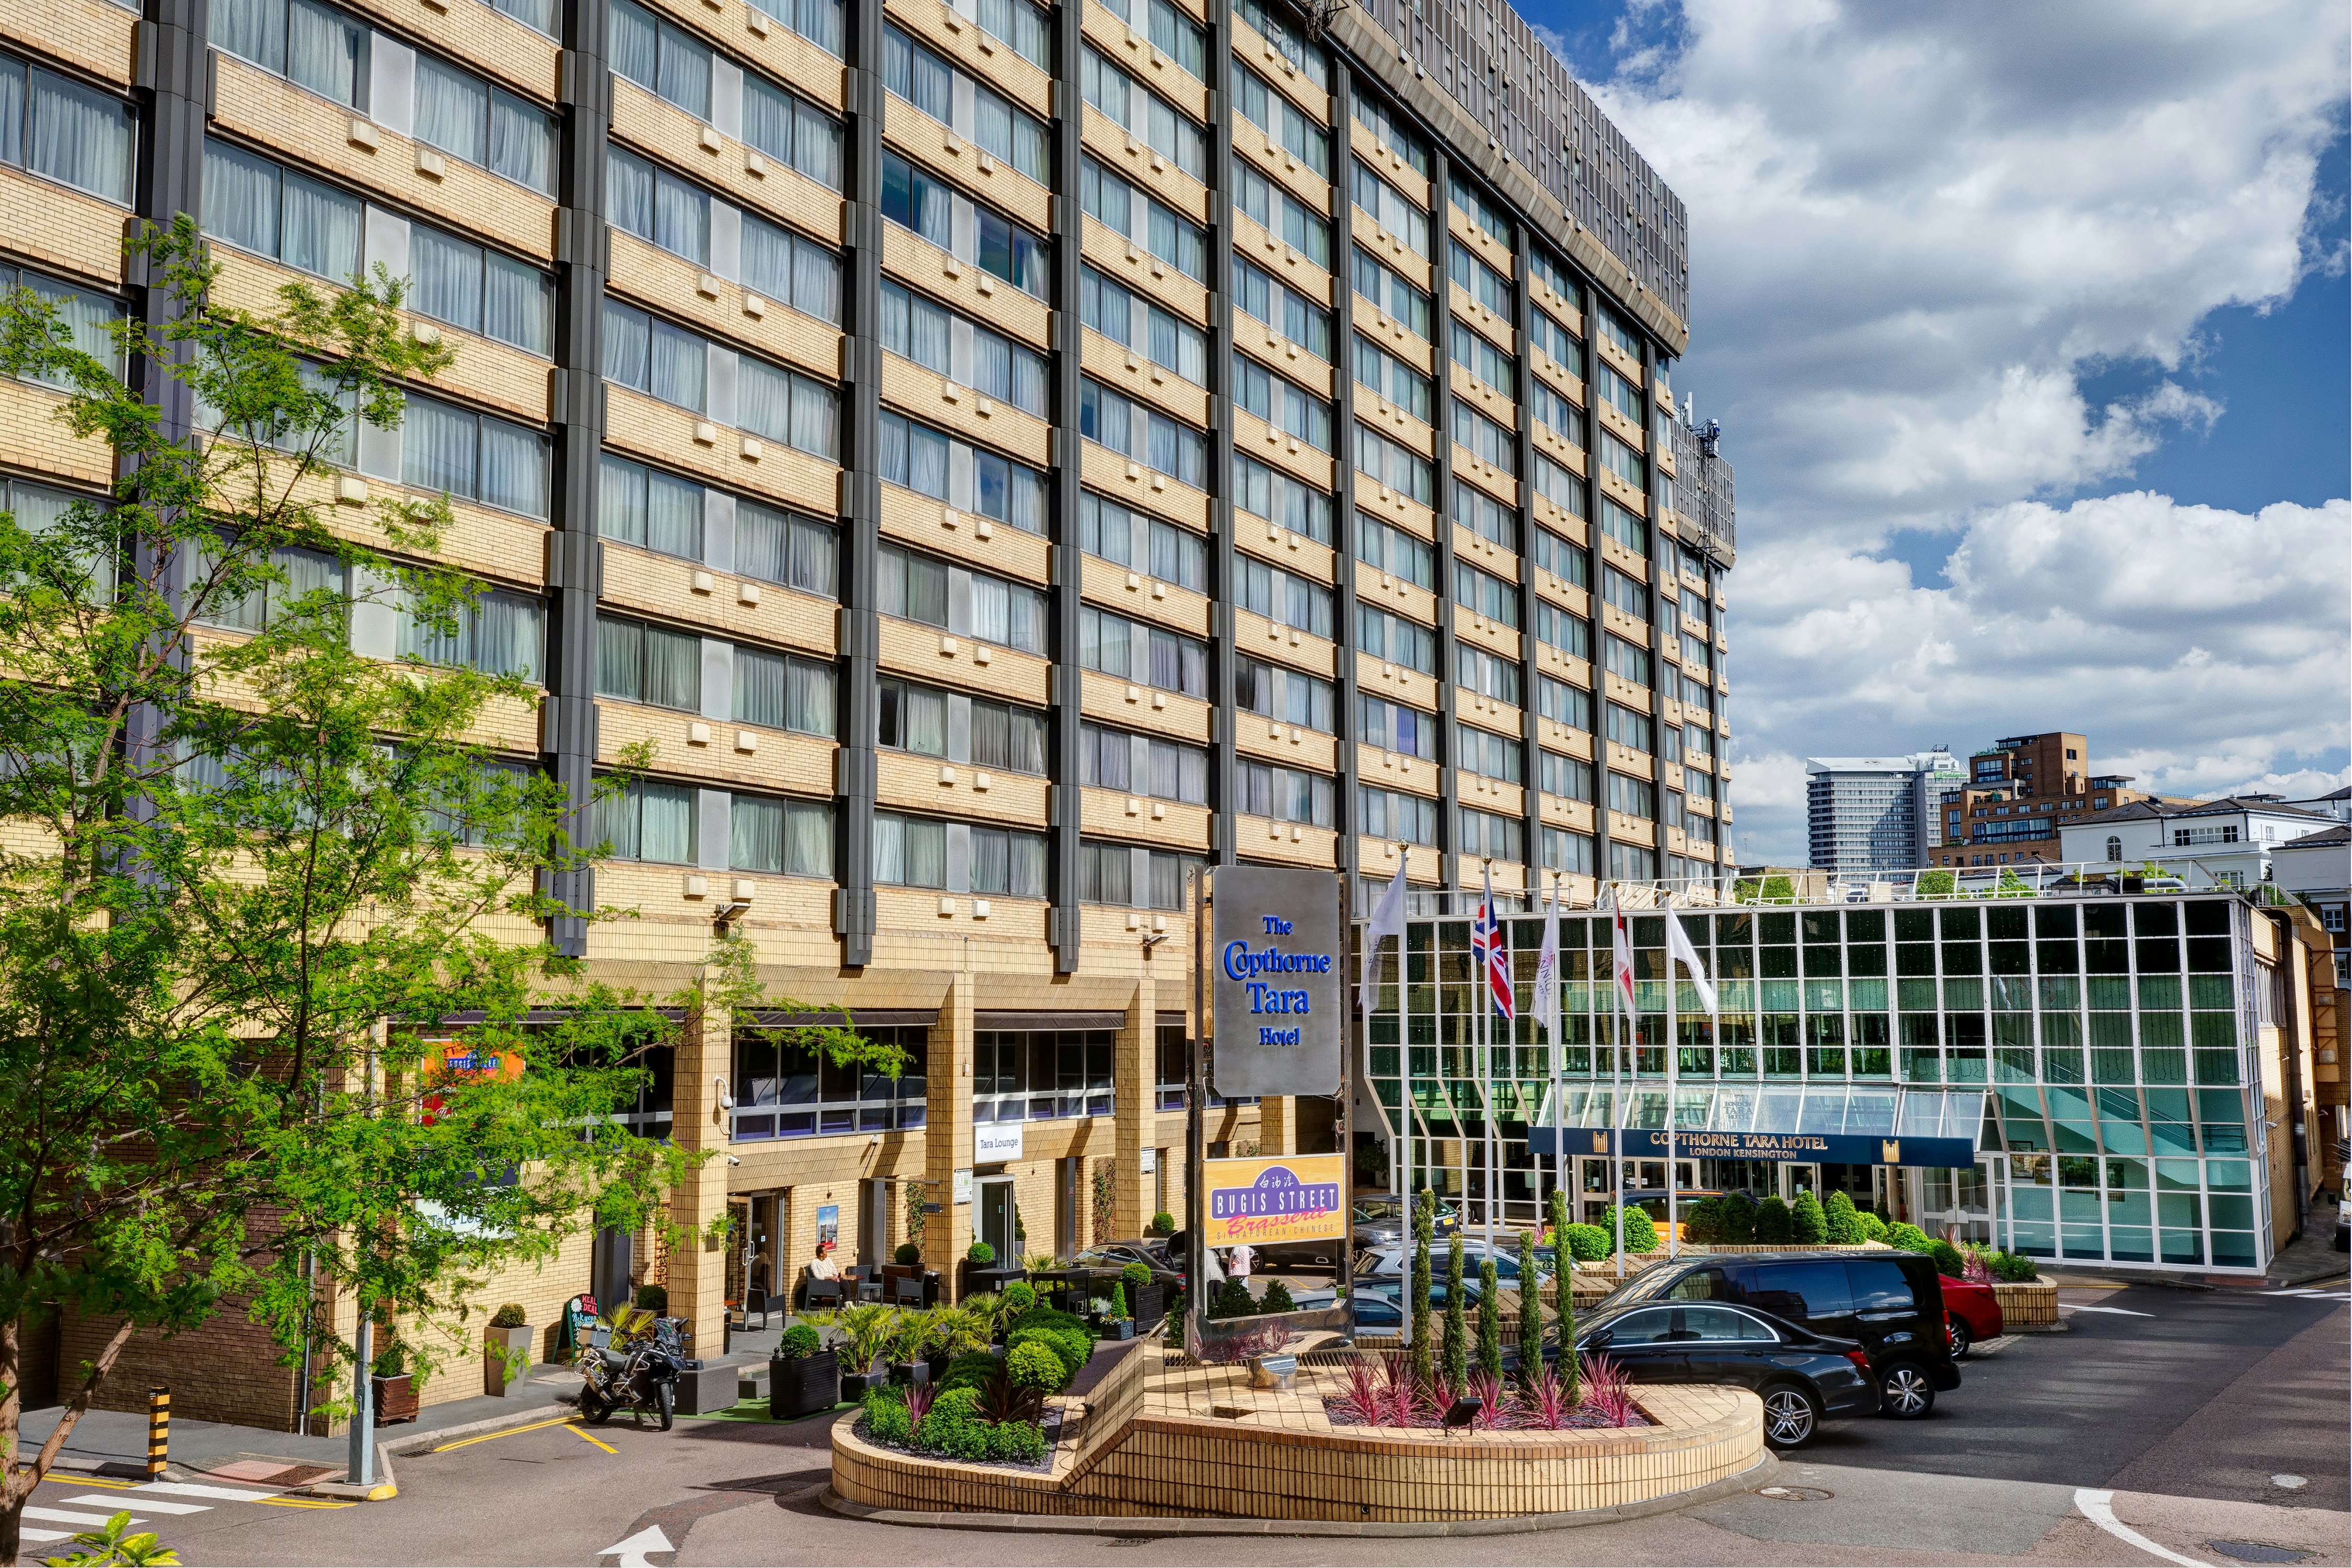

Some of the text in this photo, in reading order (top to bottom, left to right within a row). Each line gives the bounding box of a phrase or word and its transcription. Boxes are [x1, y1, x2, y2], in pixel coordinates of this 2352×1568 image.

[1263, 916, 1293, 935] The
[1224, 941, 1331, 981] Copthorne
[1246, 982, 1310, 1014] Tara
[1259, 1028, 1300, 1046] Hotel
[981, 1138, 1018, 1149] Tara Lounge
[1743, 1135, 1779, 1149] TARA
[1782, 1136, 1828, 1150] HOTEL
[1689, 1148, 1797, 1159] LONDON KENSINGTON
[1217, 1189, 1334, 1214] BUGIS STREET
[1226, 1205, 1328, 1235] Brasserie
[582, 1295, 597, 1306] MEAL
[583, 1303, 598, 1316] DEAL
